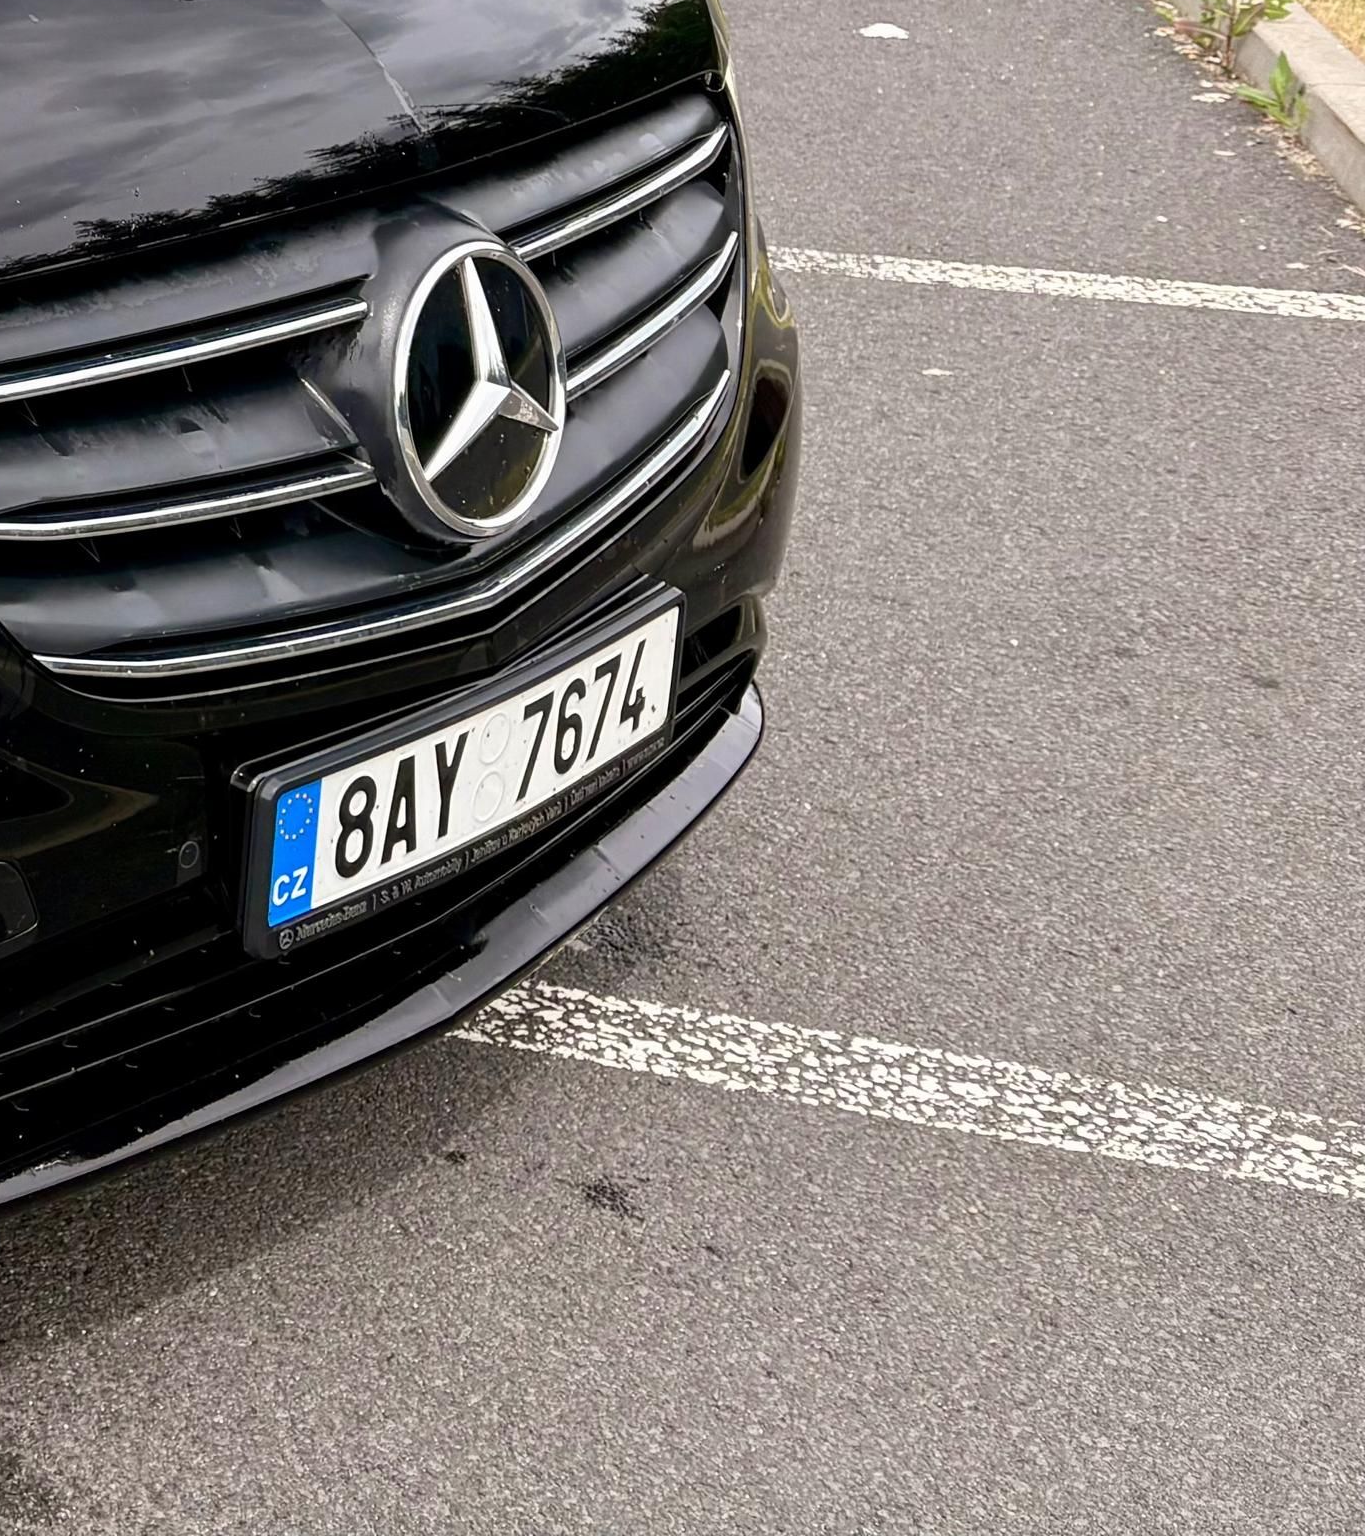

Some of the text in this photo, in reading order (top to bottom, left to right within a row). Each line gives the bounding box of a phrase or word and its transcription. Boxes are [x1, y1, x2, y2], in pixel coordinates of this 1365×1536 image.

[334, 638, 647, 880] 8AY 7674
[272, 866, 309, 907] CZ
